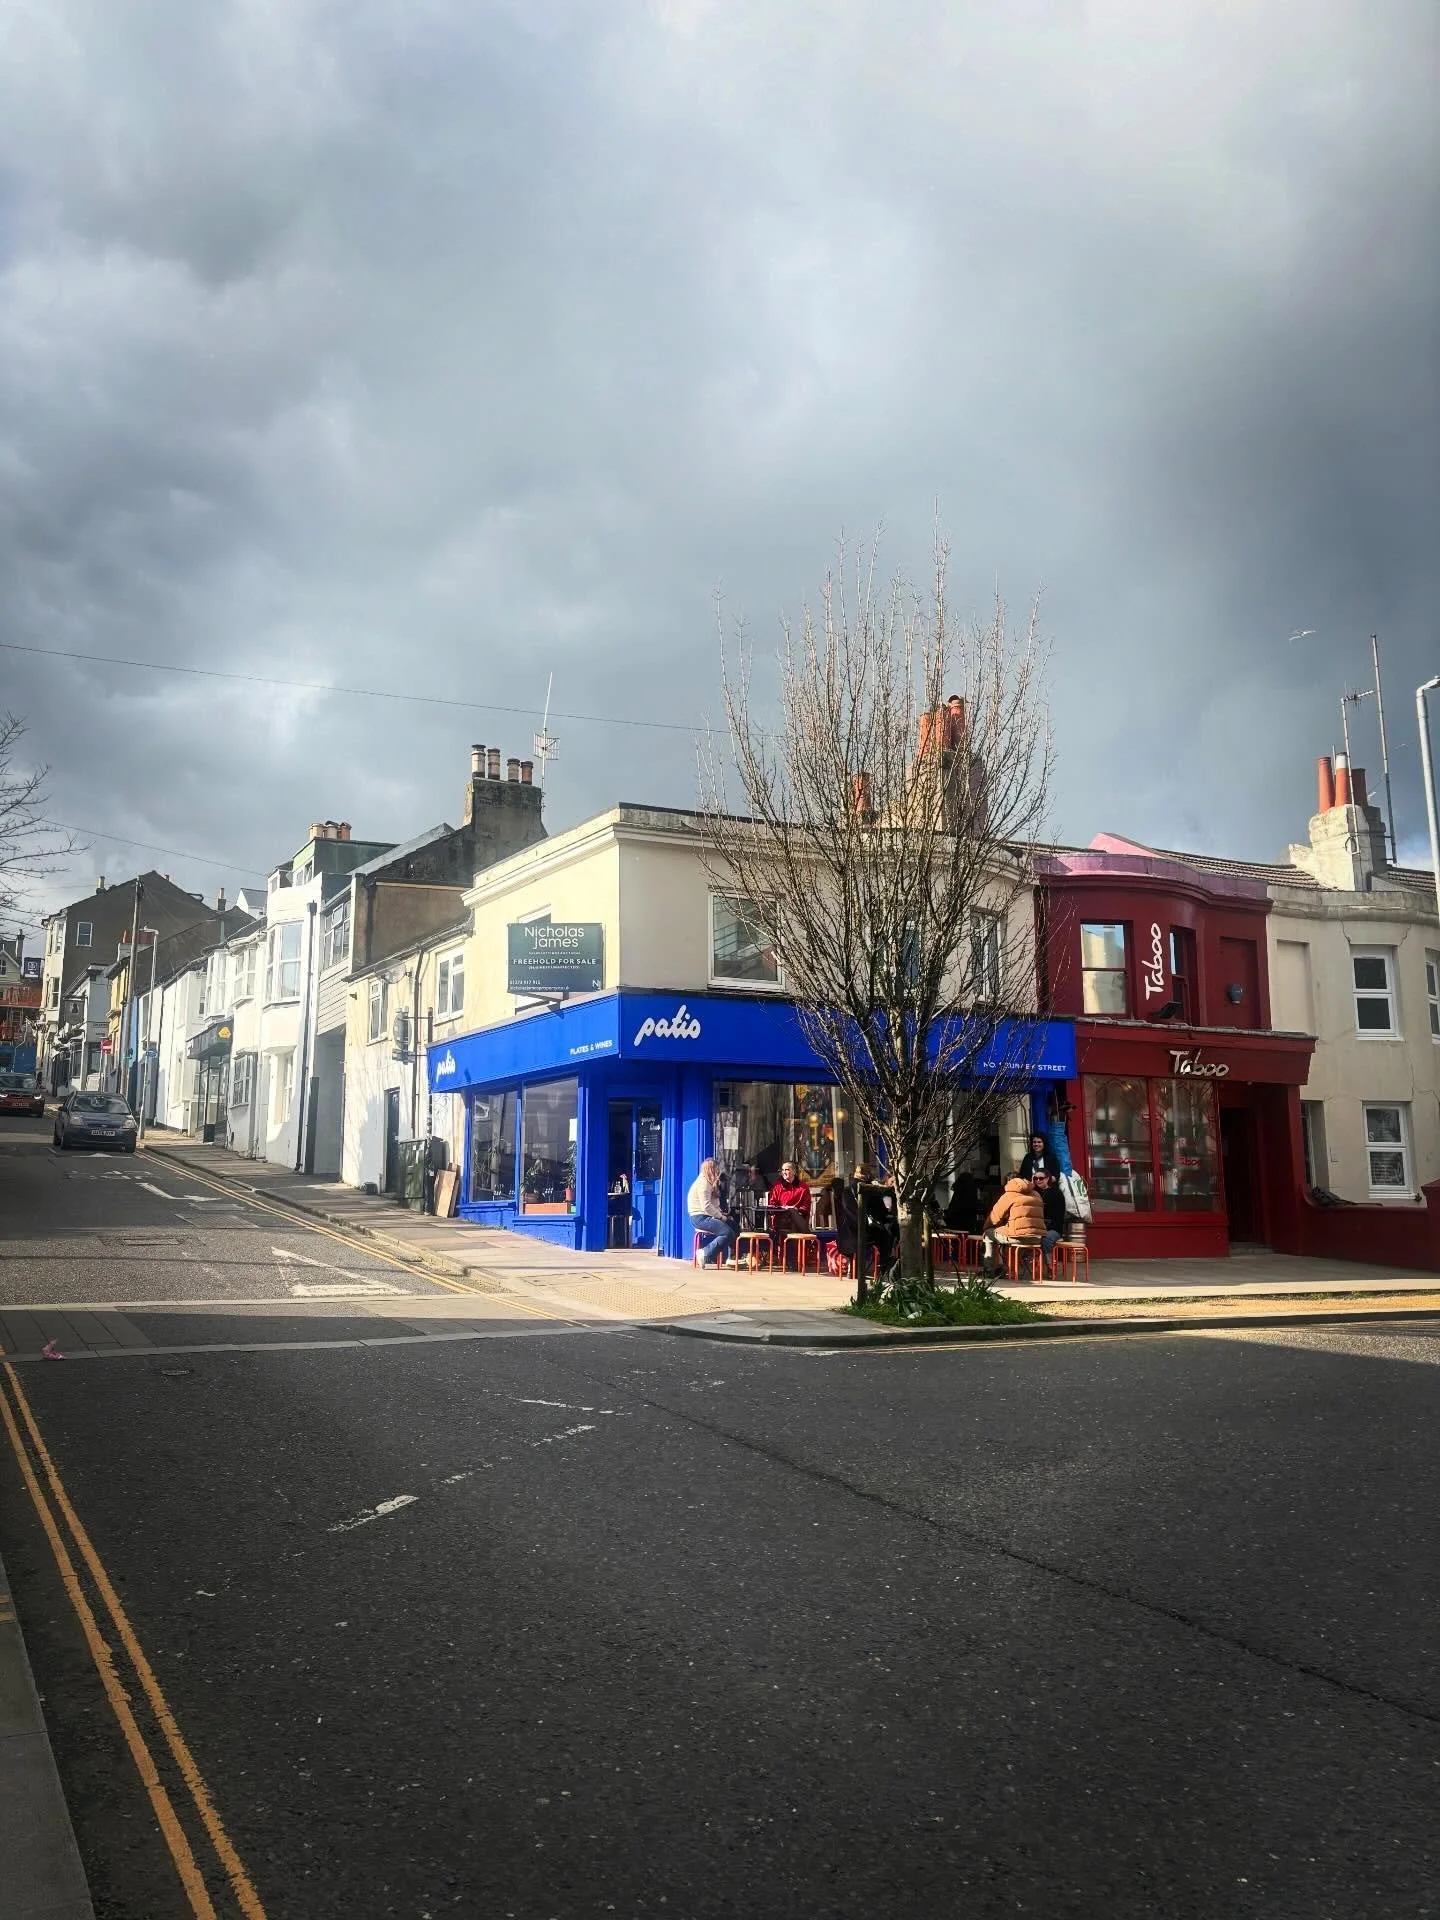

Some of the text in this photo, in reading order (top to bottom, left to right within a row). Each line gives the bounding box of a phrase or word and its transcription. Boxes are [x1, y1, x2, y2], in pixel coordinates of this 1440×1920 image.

[524, 926, 585, 938] Nicholas
[532, 936, 579, 949] James
[1141, 922, 1164, 1000] Taboo
[633, 1004, 701, 1047] patio
[570, 1045, 589, 1055] PLATES
[595, 1039, 613, 1050] WINES
[435, 1049, 456, 1083] patio
[1170, 1049, 1229, 1077] Taboo
